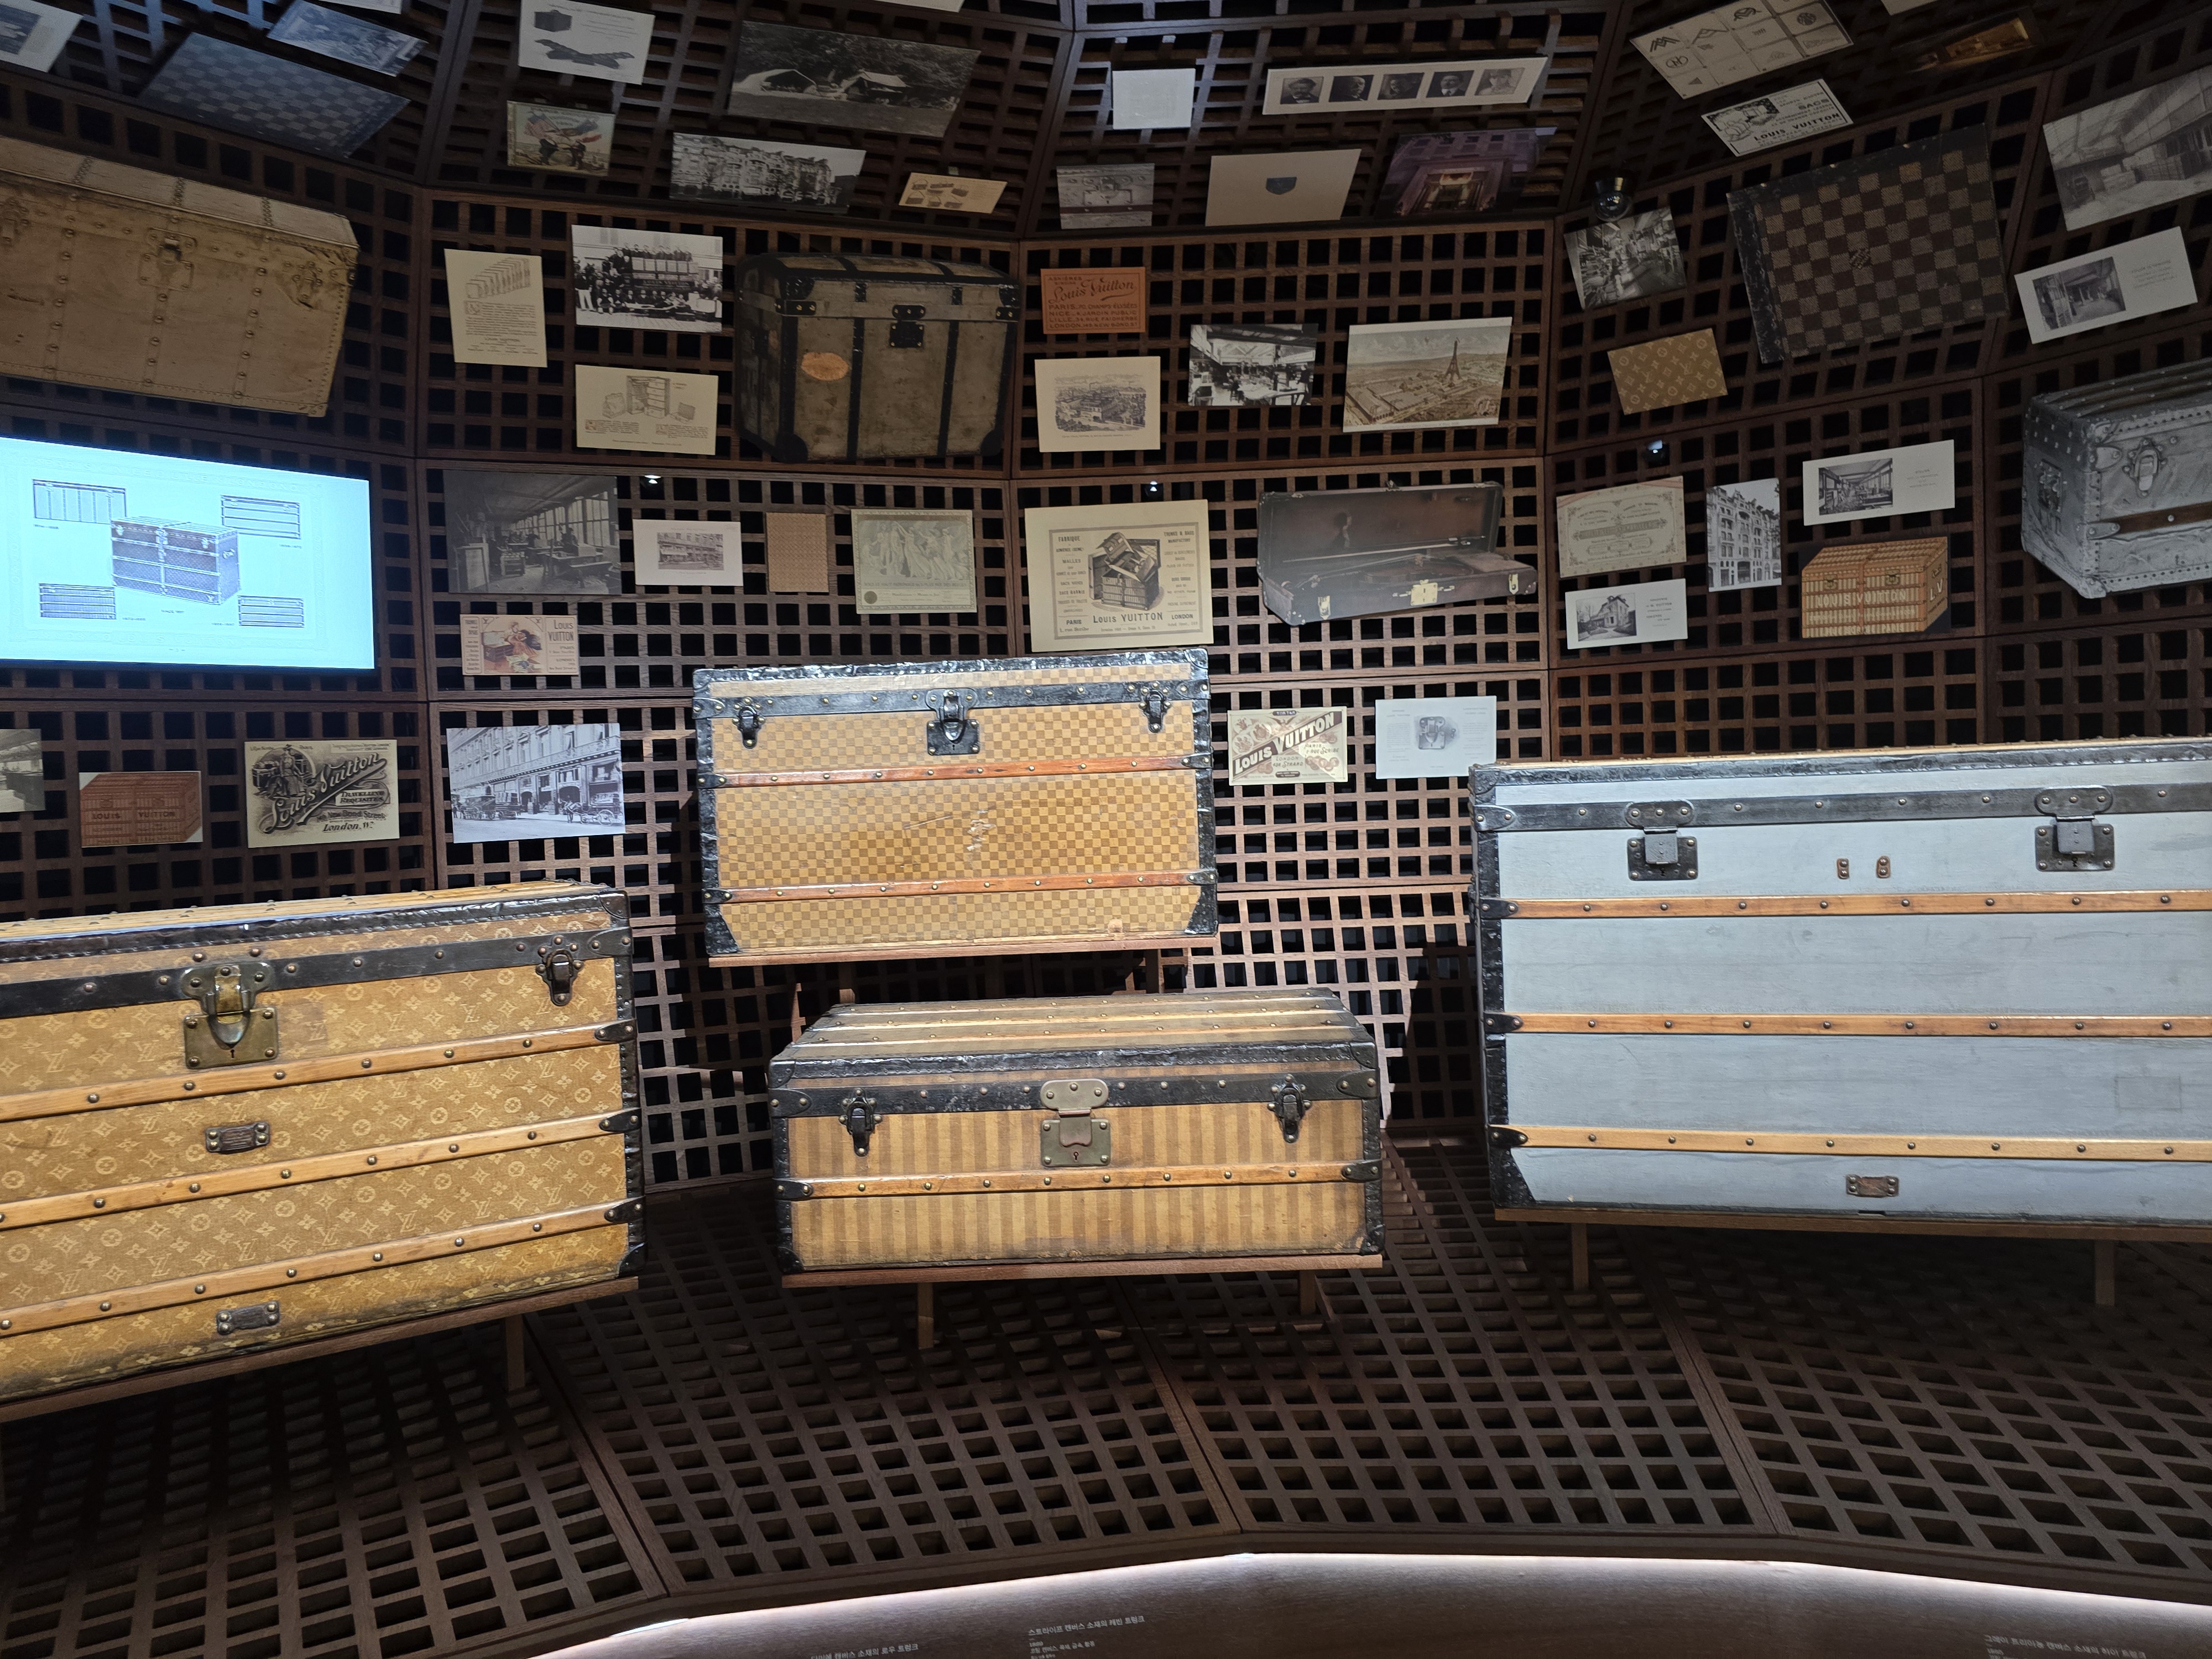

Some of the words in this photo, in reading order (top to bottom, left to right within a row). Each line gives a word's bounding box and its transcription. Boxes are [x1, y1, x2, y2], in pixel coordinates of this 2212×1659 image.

[1754, 129, 1786, 141] LOUIS
[1792, 113, 1839, 129] VUITTON
[1048, 286, 1087, 304] Louis
[1081, 276, 1134, 297] Vuitton
[1856, 591, 1907, 605] VUITTON
[1093, 615, 1117, 623] LOUIS
[1120, 612, 1164, 622] VUITTON
[547, 632, 575, 641] VUITTON
[1234, 746, 1272, 775] LOUIS
[1272, 712, 1335, 754] VUITTON
[258, 790, 317, 834] Louis
[318, 752, 382, 793] Vuitton
[1029, 1625, 1064, 1636] 스트라이프
[1065, 1623, 1086, 1632] 캔버스
[1087, 1620, 1108, 1629] 소재의
[1125, 1615, 1146, 1624] 트렁크
[857, 1647, 879, 1657] 소재의
[897, 1643, 919, 1653] 트렁크
